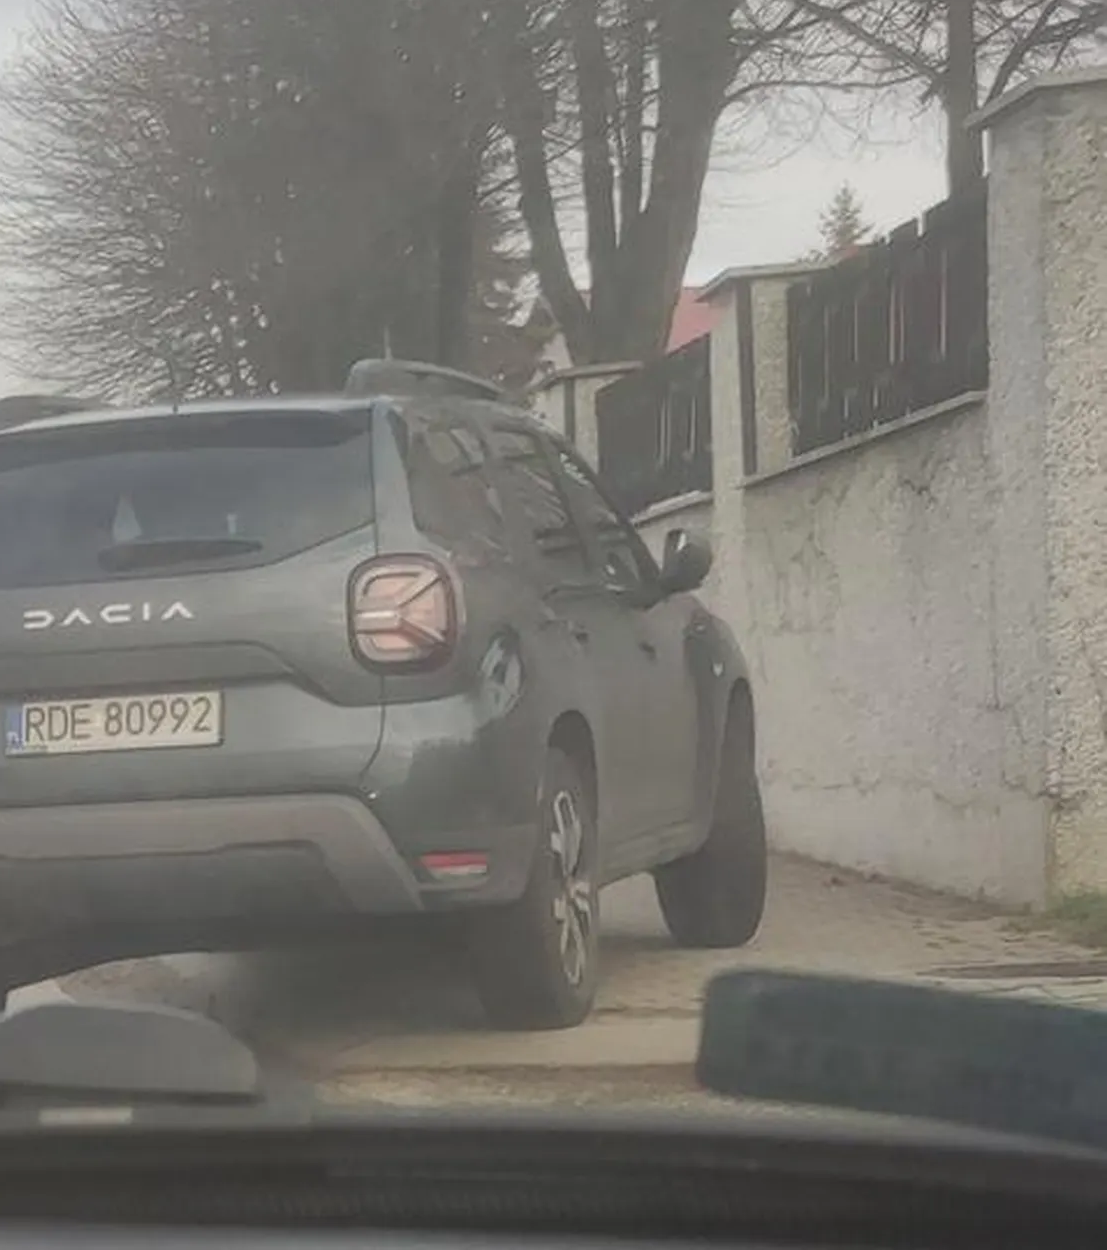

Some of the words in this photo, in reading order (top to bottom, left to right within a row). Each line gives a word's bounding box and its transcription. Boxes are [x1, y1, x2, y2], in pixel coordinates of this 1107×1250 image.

[22, 601, 193, 630] DACIA
[25, 703, 92, 743] RDE
[104, 696, 212, 736] 80992
